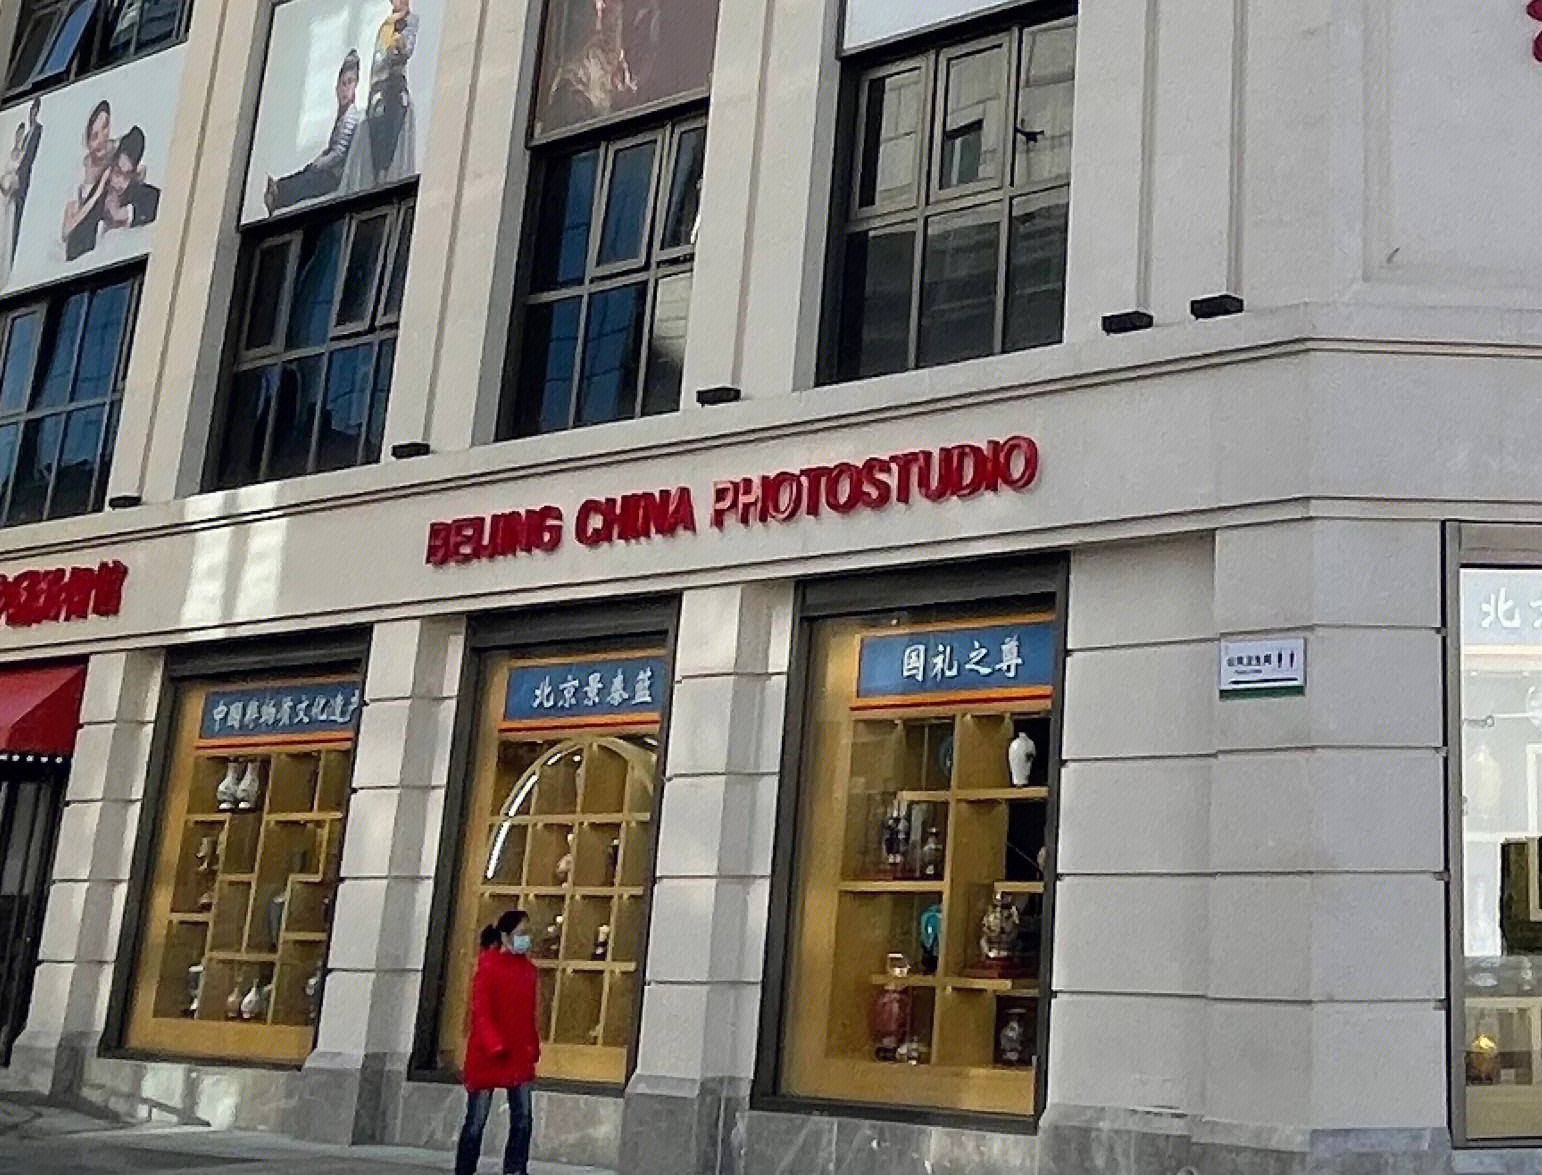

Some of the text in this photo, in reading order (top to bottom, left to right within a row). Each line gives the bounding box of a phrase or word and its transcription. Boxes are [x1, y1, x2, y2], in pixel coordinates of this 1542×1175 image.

[426, 506, 562, 564] BEIJING
[575, 486, 697, 546] CHINA
[903, 634, 1022, 682] 国礼之尊
[532, 666, 652, 708] 北京景泰蓝
